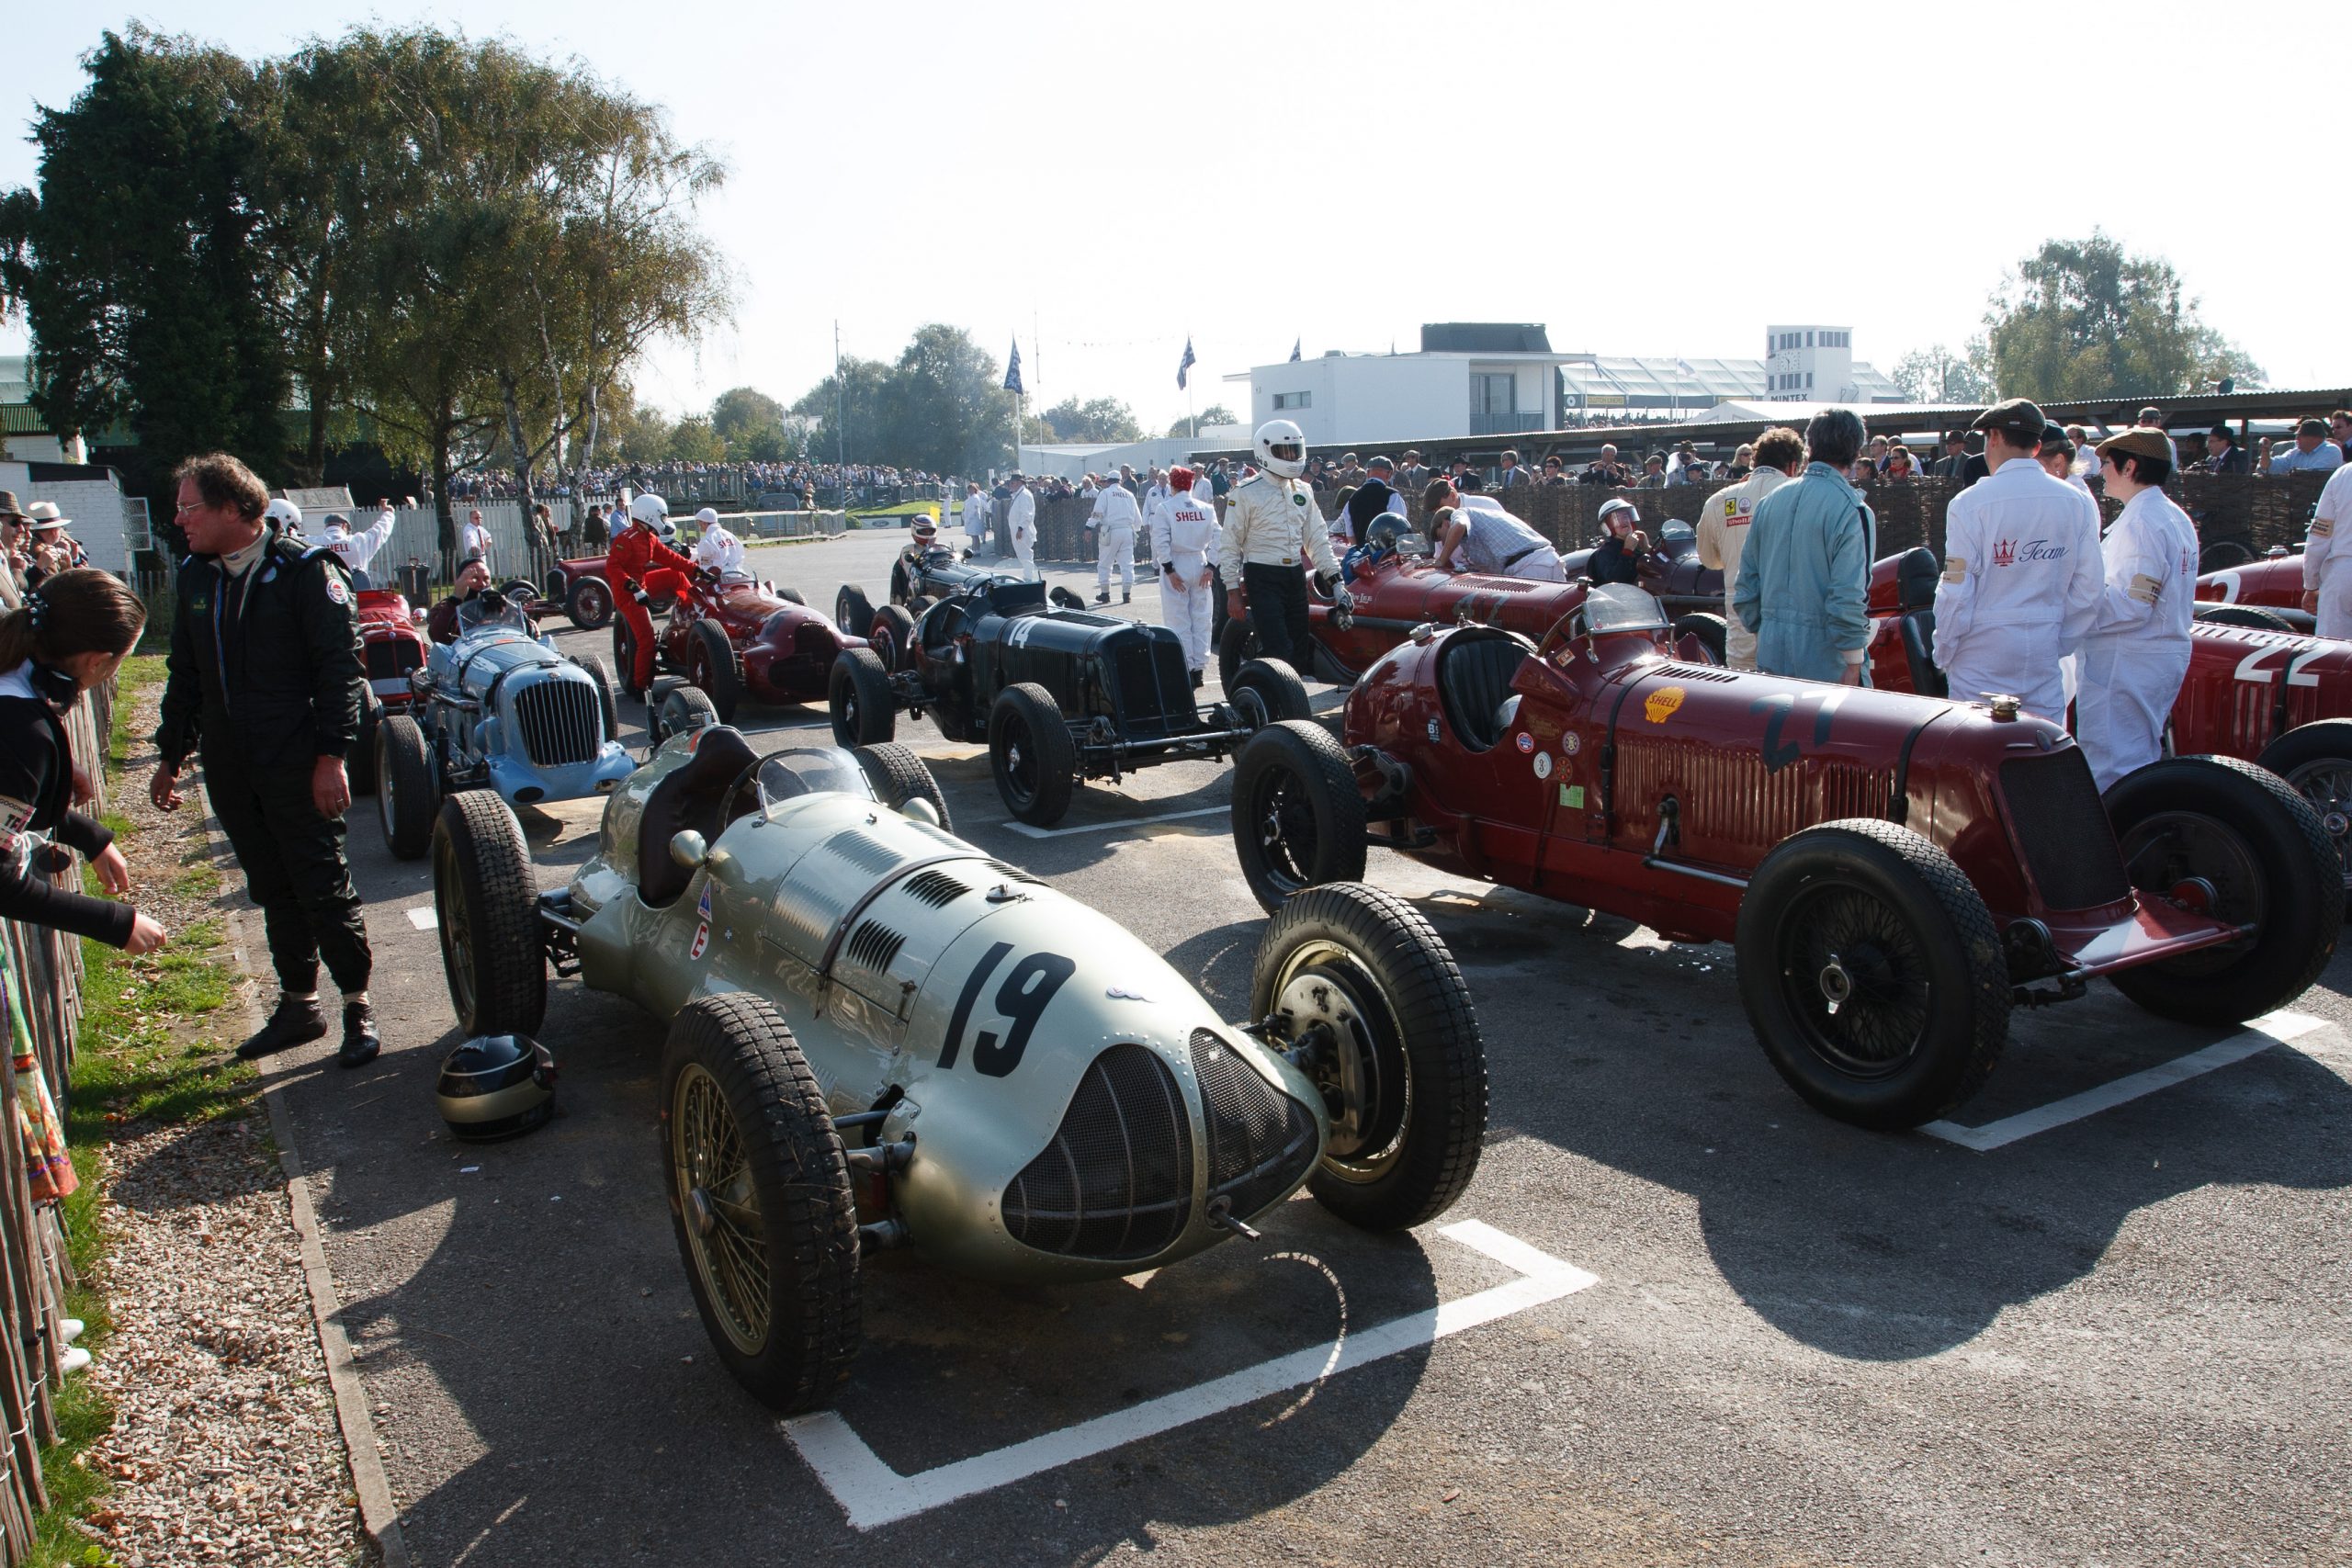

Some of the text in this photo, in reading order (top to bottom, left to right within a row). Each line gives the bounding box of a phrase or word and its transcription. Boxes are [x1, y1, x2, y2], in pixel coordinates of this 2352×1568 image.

[1770, 394, 1808, 402] MINTEX
[1176, 512, 1205, 522] SHELL
[322, 544, 351, 552] HELL
[2018, 539, 2069, 562] Team
[1008, 615, 1048, 649] 14
[2233, 640, 2337, 687] 22
[1649, 694, 1678, 707] SHELL
[1749, 689, 1849, 776] 27
[935, 941, 1077, 1078] 19
